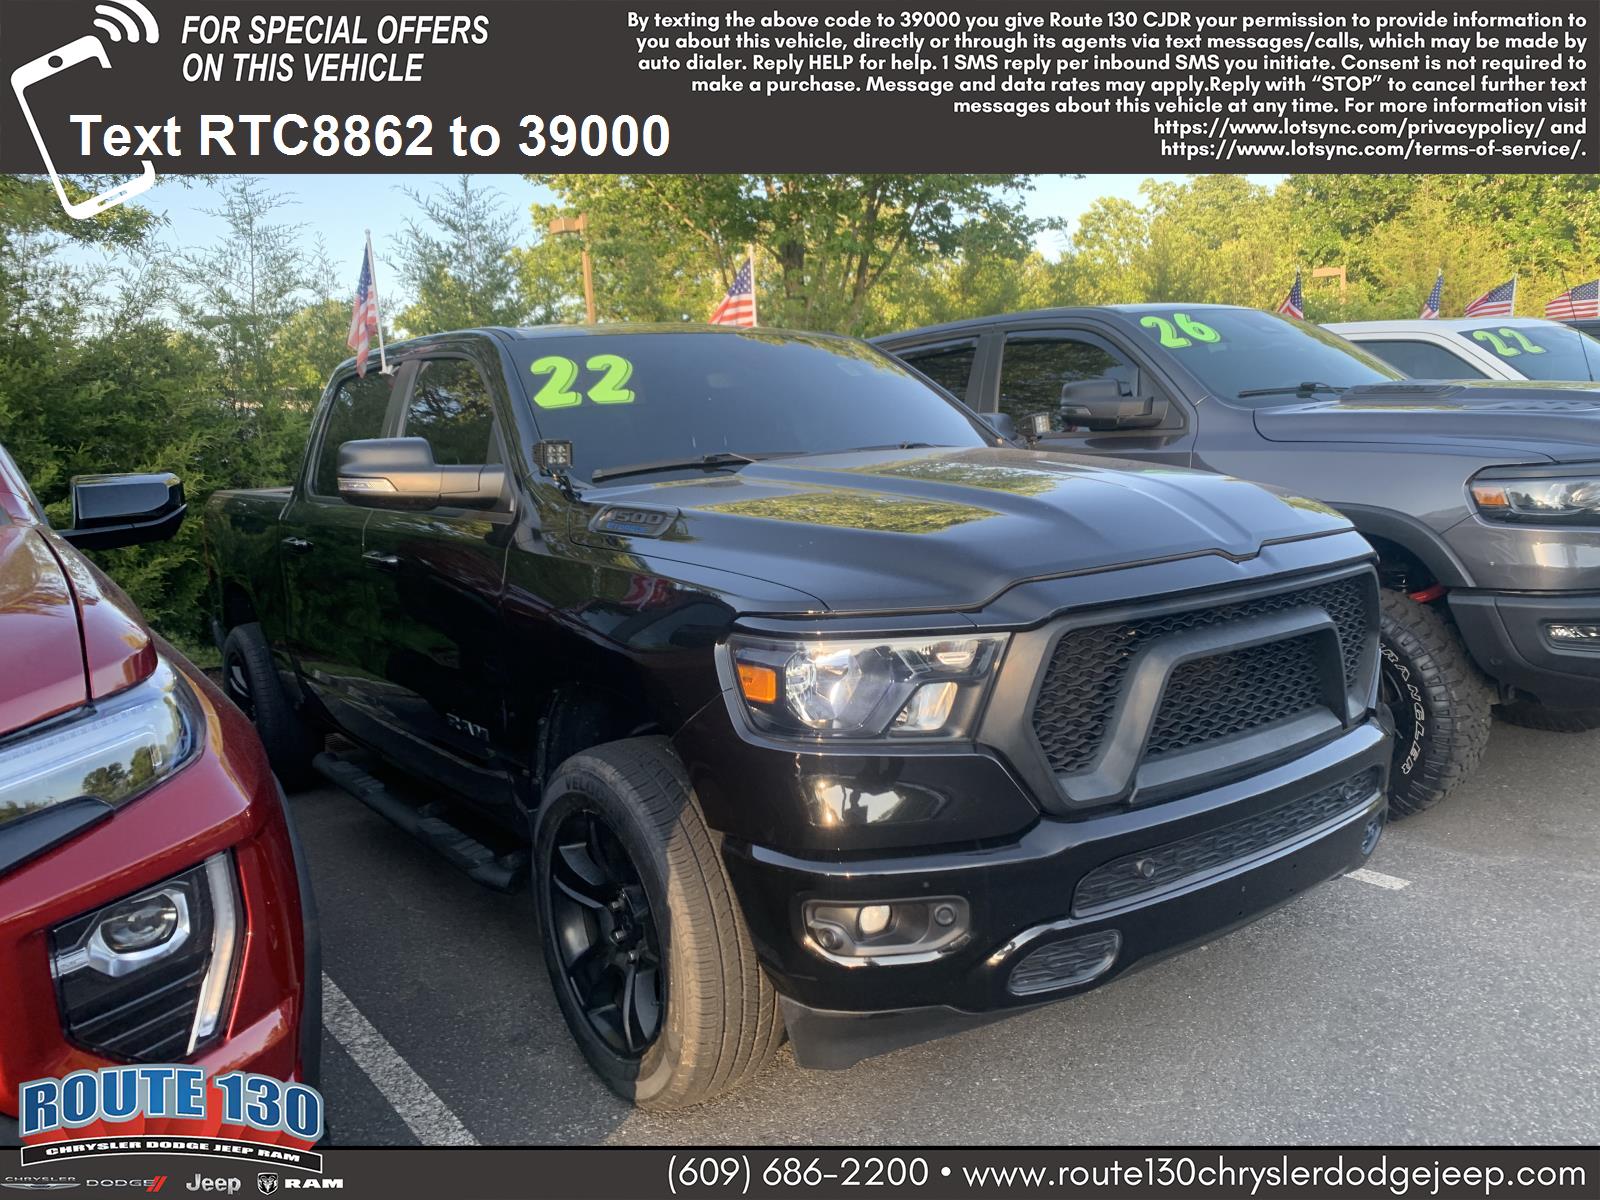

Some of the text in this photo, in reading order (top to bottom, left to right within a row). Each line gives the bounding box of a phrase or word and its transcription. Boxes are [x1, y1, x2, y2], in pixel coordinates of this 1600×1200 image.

[1140, 313, 1221, 348] 26
[1472, 327, 1547, 356] 22
[530, 354, 635, 409] 22
[1379, 643, 1425, 774] RANGLER
